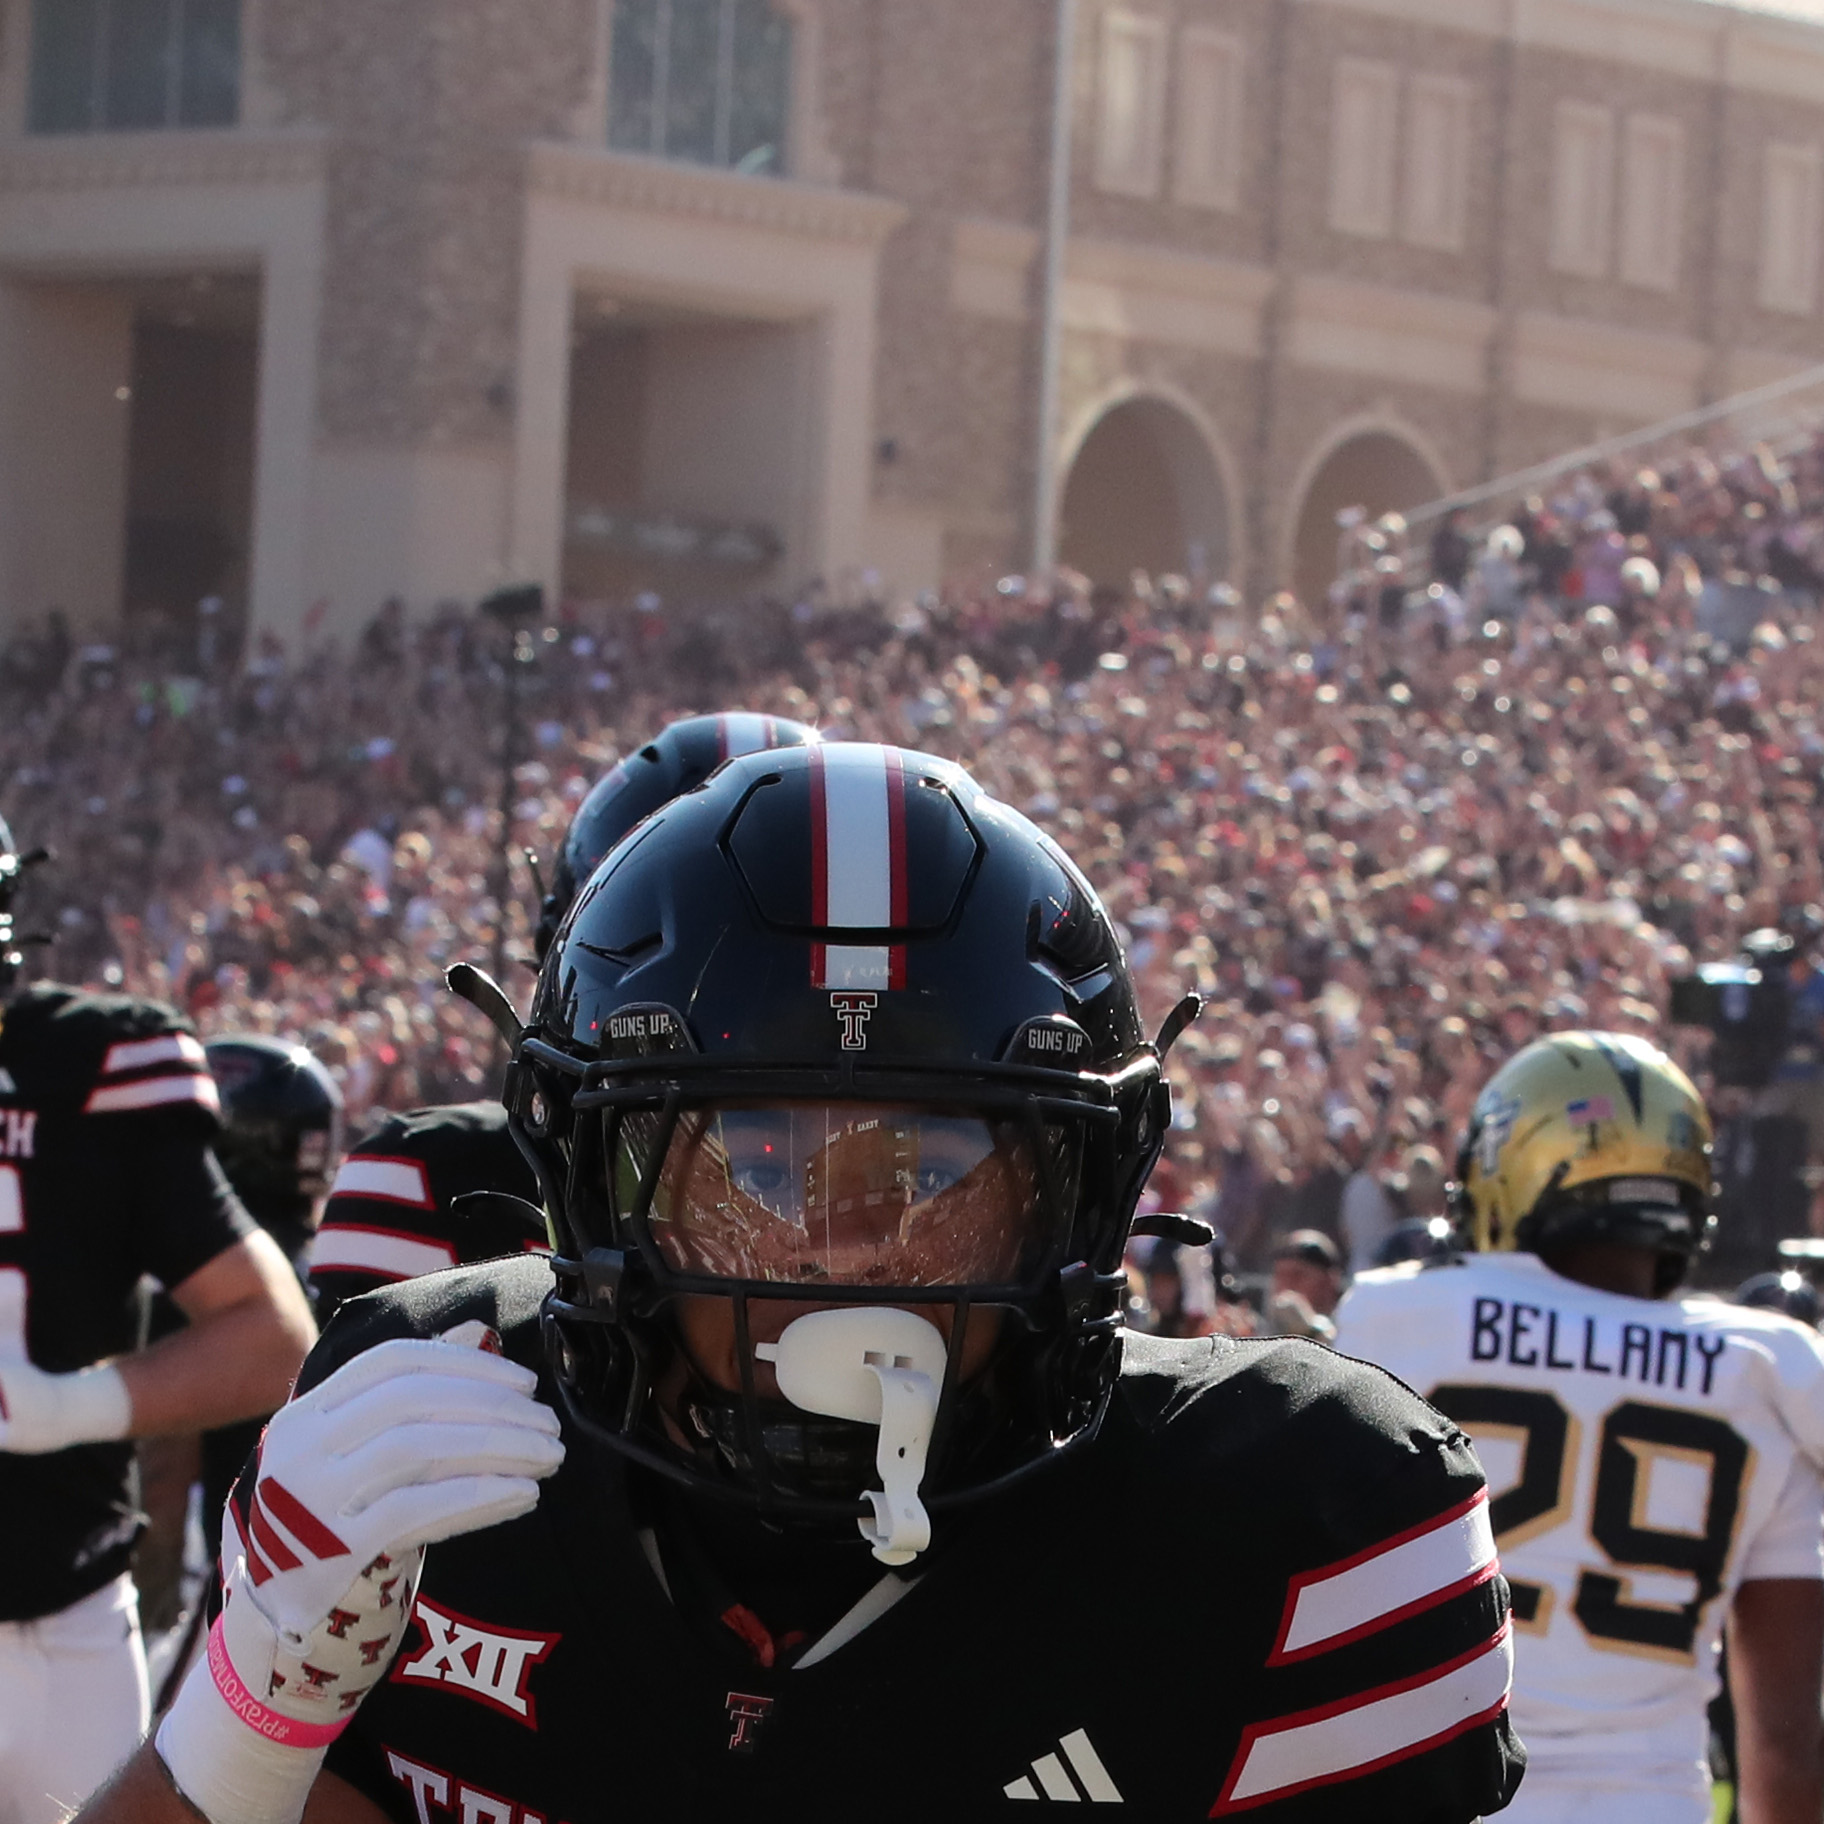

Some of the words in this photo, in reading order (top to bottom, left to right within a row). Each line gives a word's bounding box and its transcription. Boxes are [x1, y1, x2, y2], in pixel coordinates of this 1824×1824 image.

[610, 1015, 645, 1039] GUNS
[650, 1013, 670, 1035] UP
[1028, 1029, 1063, 1051] GUNS
[1066, 1032, 1083, 1054] UP
[1471, 1296, 1727, 1396] BELLAMY
[1426, 1383, 1760, 1668] 29
[396, 1597, 556, 1724] XII
